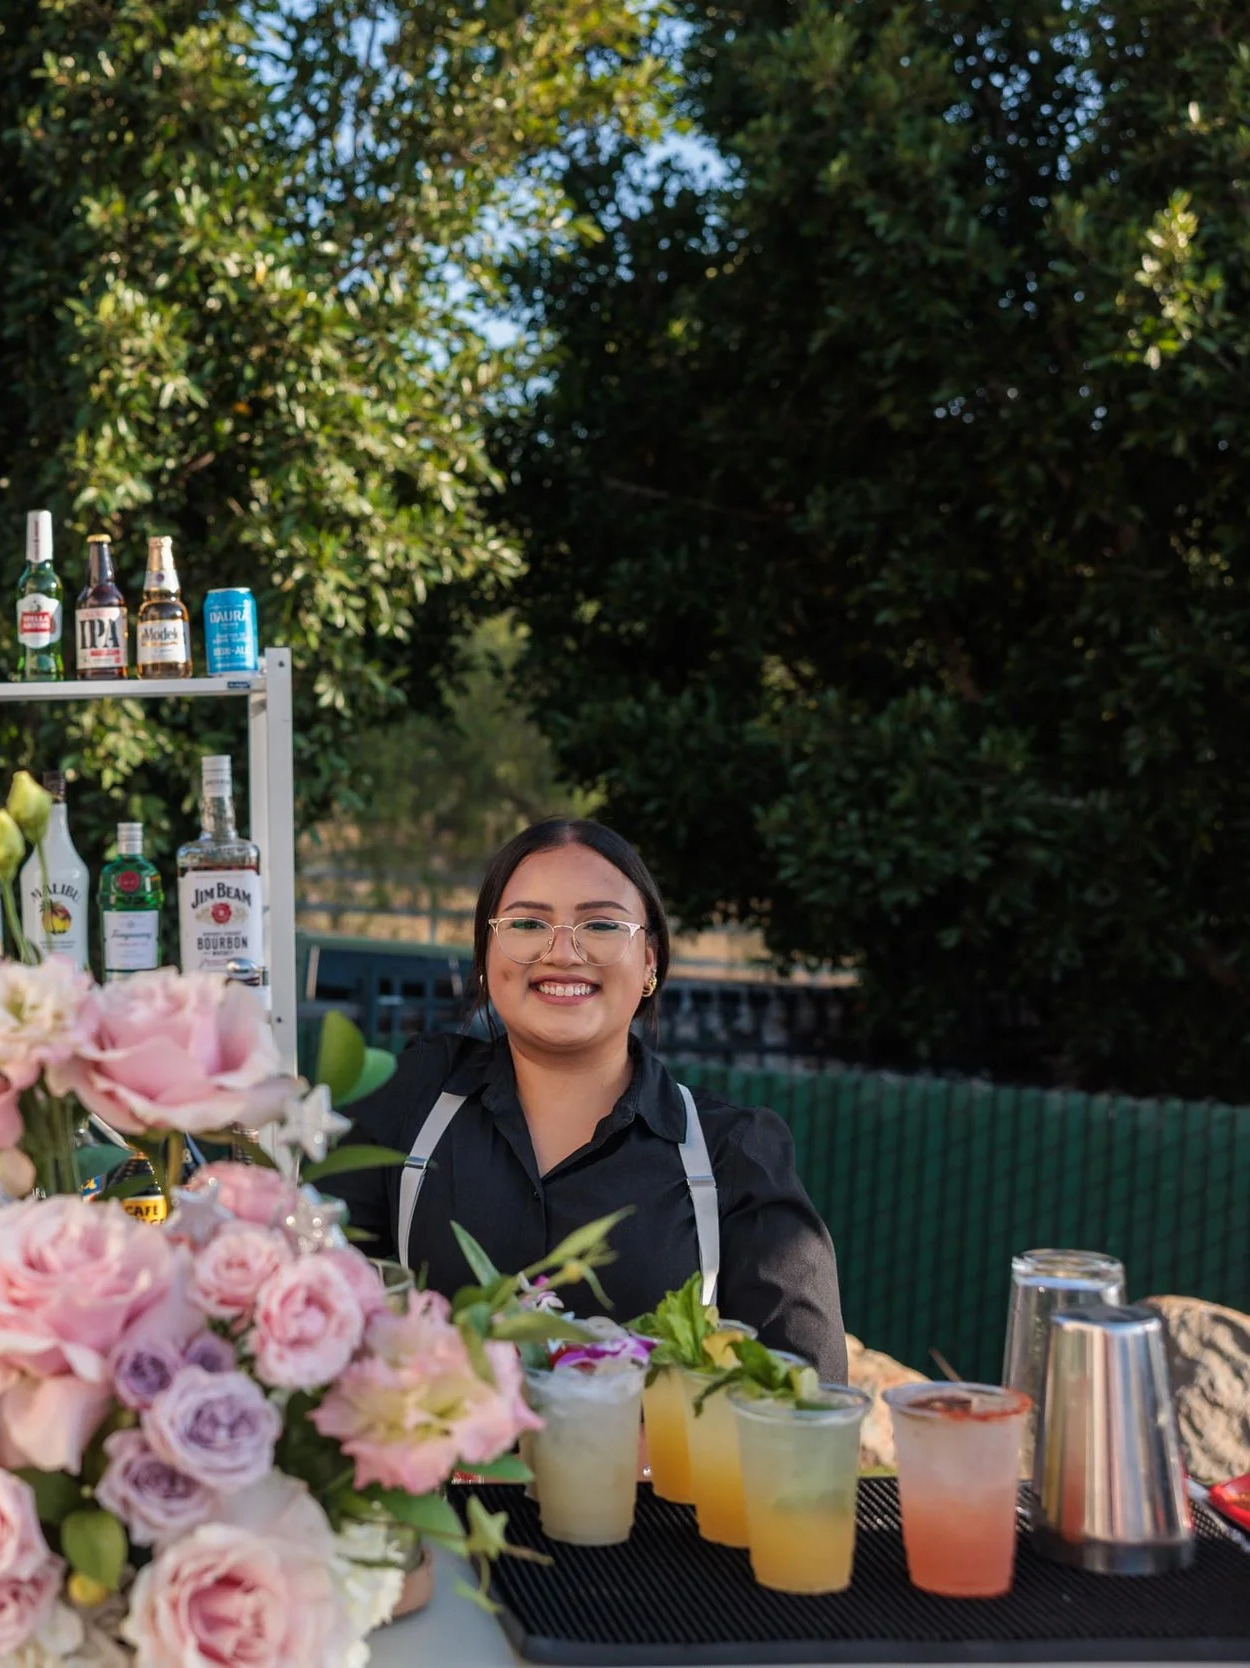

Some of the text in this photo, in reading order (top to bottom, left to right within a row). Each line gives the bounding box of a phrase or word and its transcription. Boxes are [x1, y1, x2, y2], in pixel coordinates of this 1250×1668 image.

[209, 610, 251, 623] DAURA
[79, 619, 120, 649] IPA
[191, 882, 252, 909] JIM BEAM
[197, 936, 248, 950] BOURBON
